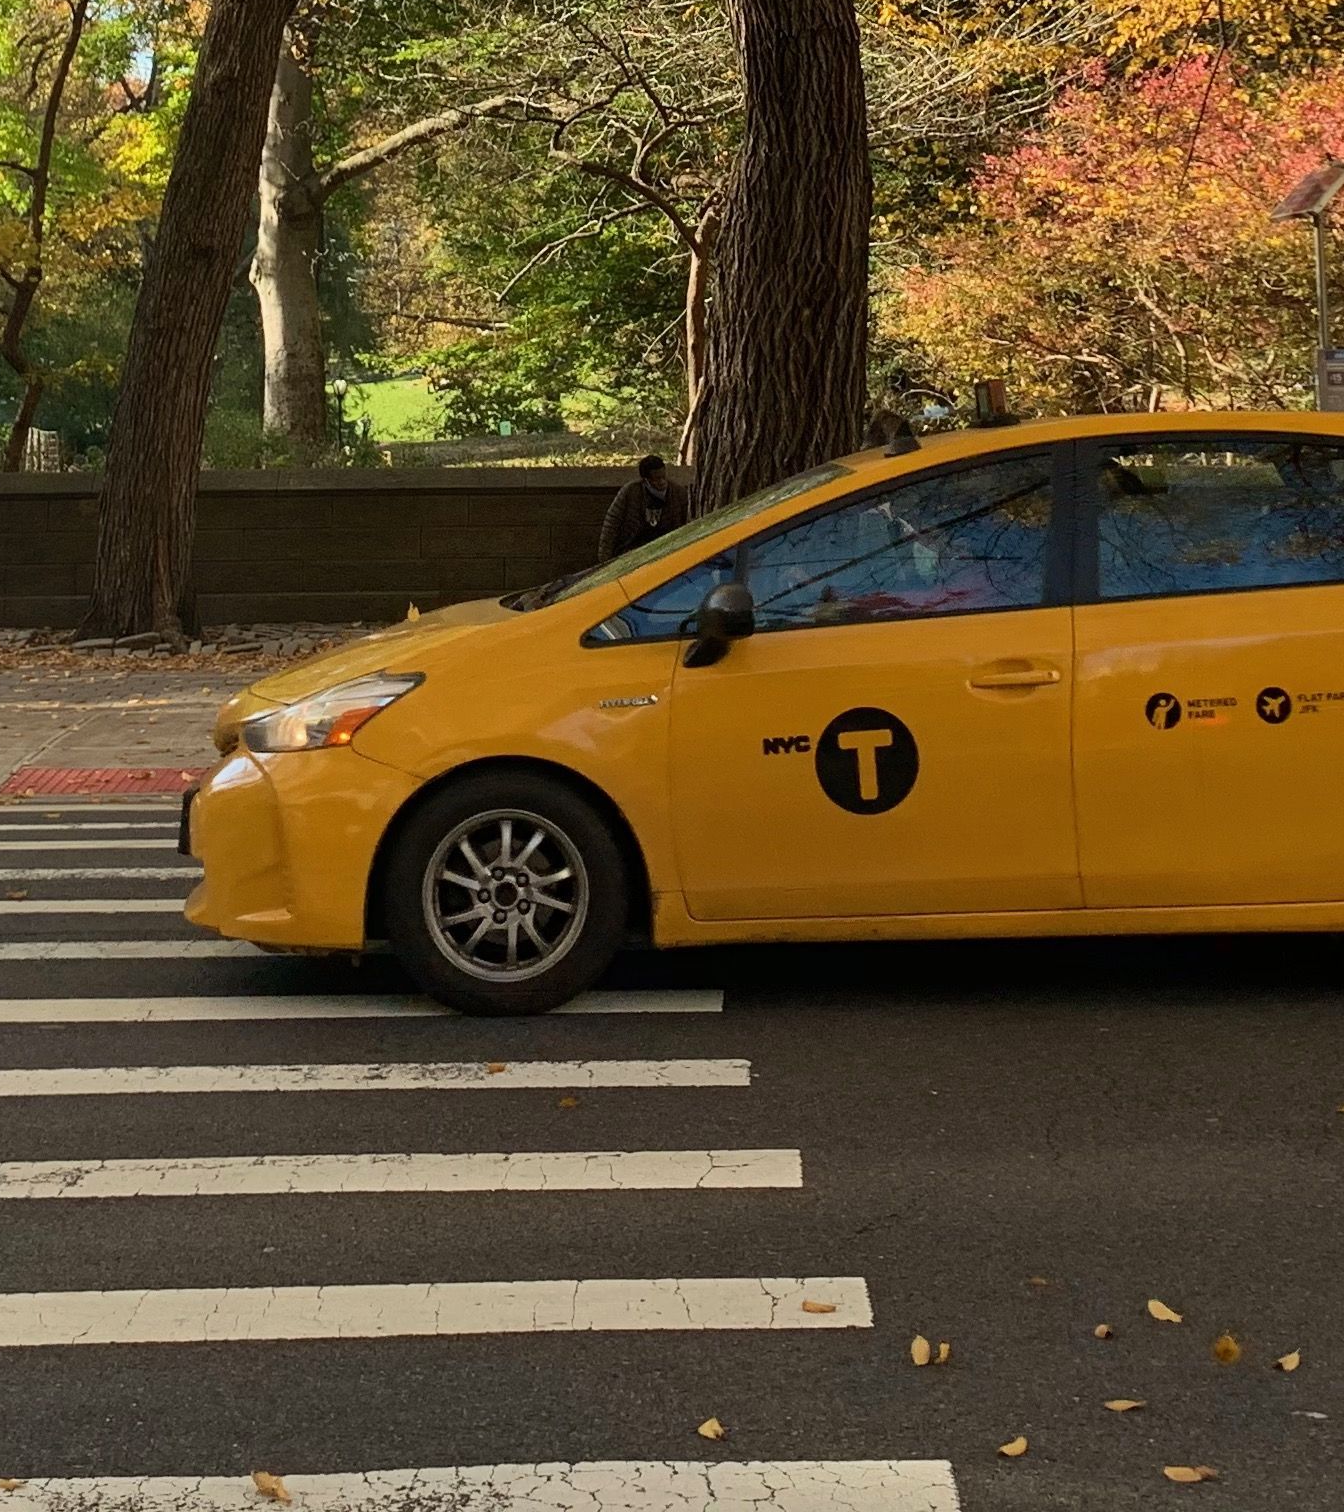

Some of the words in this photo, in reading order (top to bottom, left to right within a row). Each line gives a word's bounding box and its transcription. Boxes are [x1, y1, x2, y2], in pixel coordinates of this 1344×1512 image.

[1187, 697, 1237, 707] METERED
[1187, 709, 1216, 719] FARE
[762, 735, 811, 755] NYC
[837, 729, 894, 801] T
